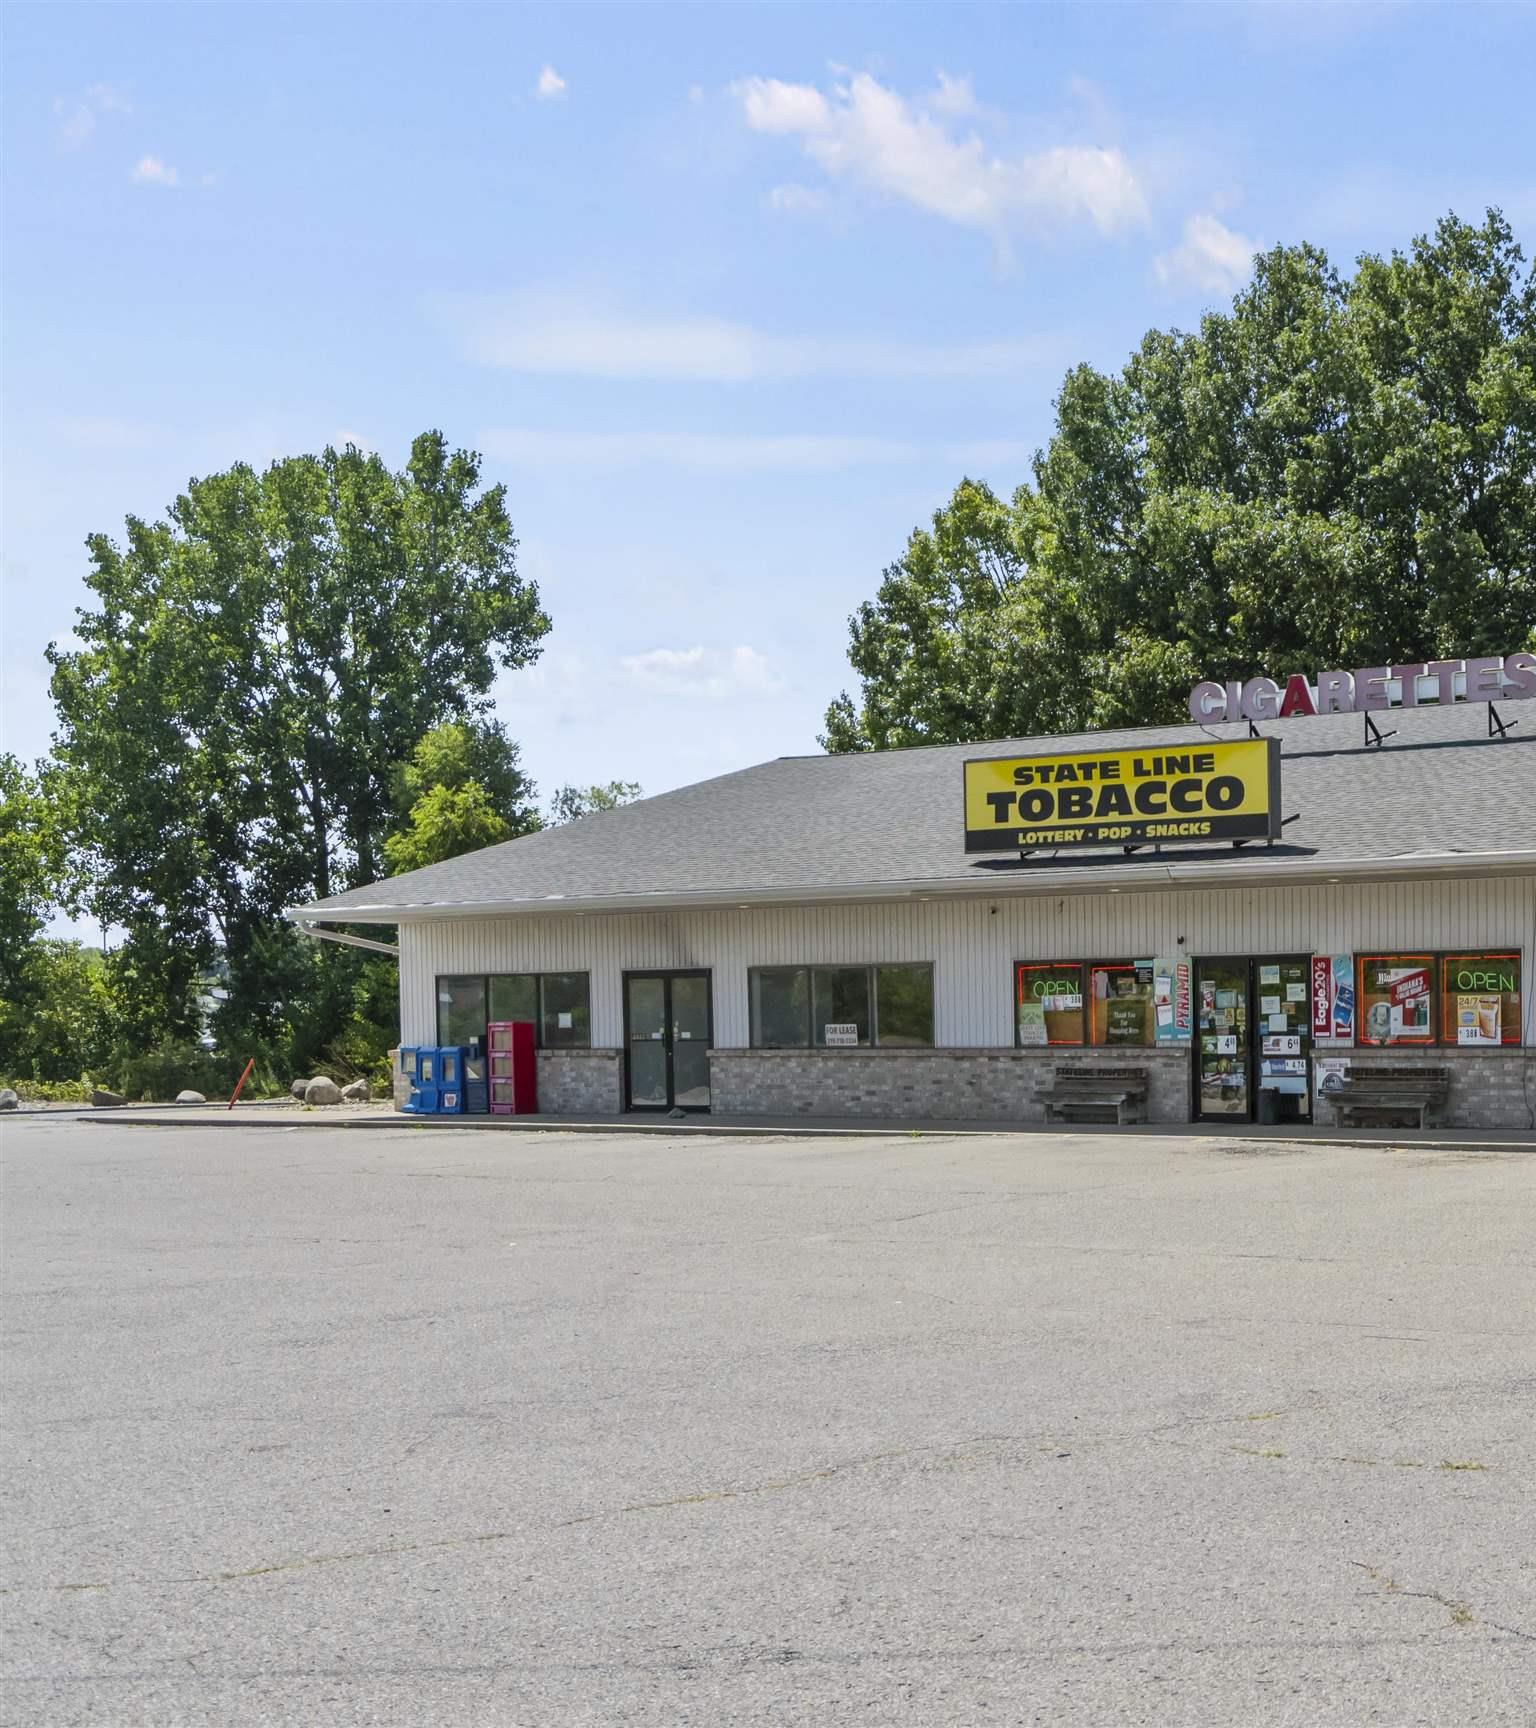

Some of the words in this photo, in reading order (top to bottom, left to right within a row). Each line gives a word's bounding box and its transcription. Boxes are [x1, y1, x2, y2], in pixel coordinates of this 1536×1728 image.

[1013, 760, 1120, 786] STATE
[1133, 753, 1215, 777] LINE
[986, 775, 1245, 824] TOBACCO
[1018, 829, 1084, 844] LOTTERY
[1098, 826, 1132, 840] POP
[1146, 822, 1211, 837] SNACKS
[1033, 980, 1079, 998] OPEN
[1457, 970, 1514, 992] OPEN
[1176, 962, 1190, 1030] PYRAMID
[1458, 996, 1478, 1005] 24/7
